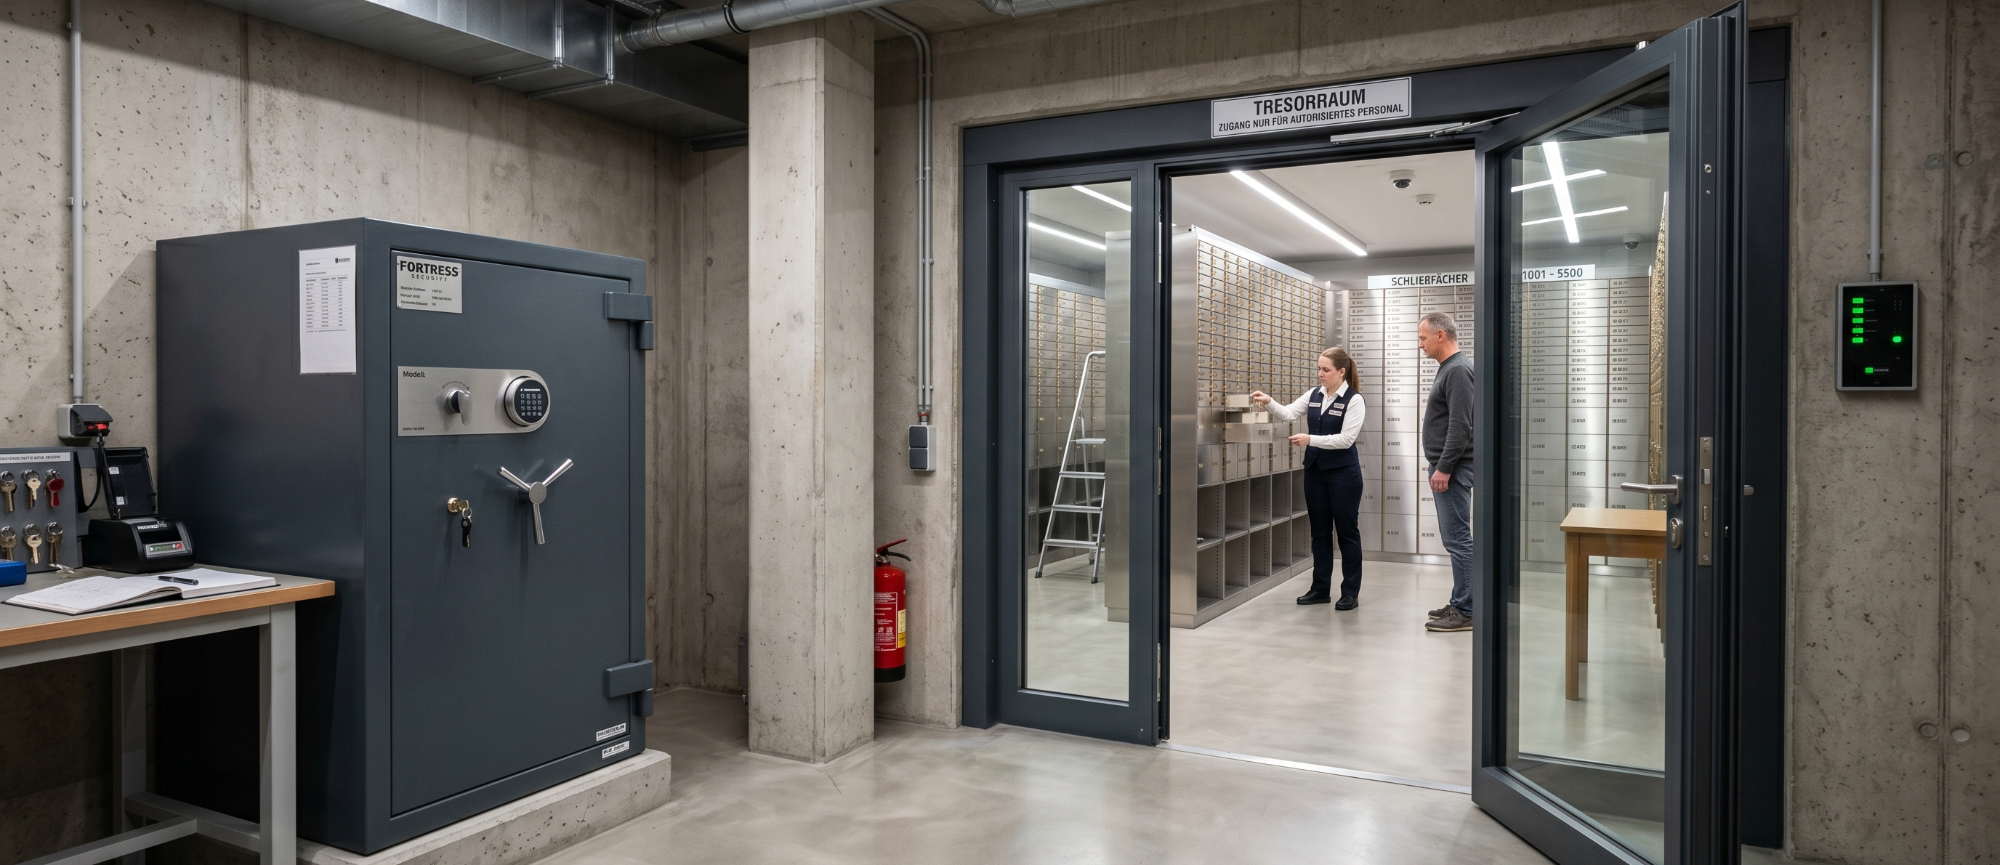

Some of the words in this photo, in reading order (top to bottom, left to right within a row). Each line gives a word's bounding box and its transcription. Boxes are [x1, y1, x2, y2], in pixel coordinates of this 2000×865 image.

[1254, 88, 1366, 115] TRESORRAUM
[1218, 120, 1251, 131] ZUGANG
[1252, 118, 1270, 128] NUR
[1272, 115, 1289, 126] FÜR
[1290, 109, 1355, 124] AUTORISIERTES
[1357, 103, 1404, 117] PERSONAL
[400, 260, 459, 277] FORTRESS
[1522, 269, 1546, 280] 1001
[1557, 268, 1583, 279] 5500
